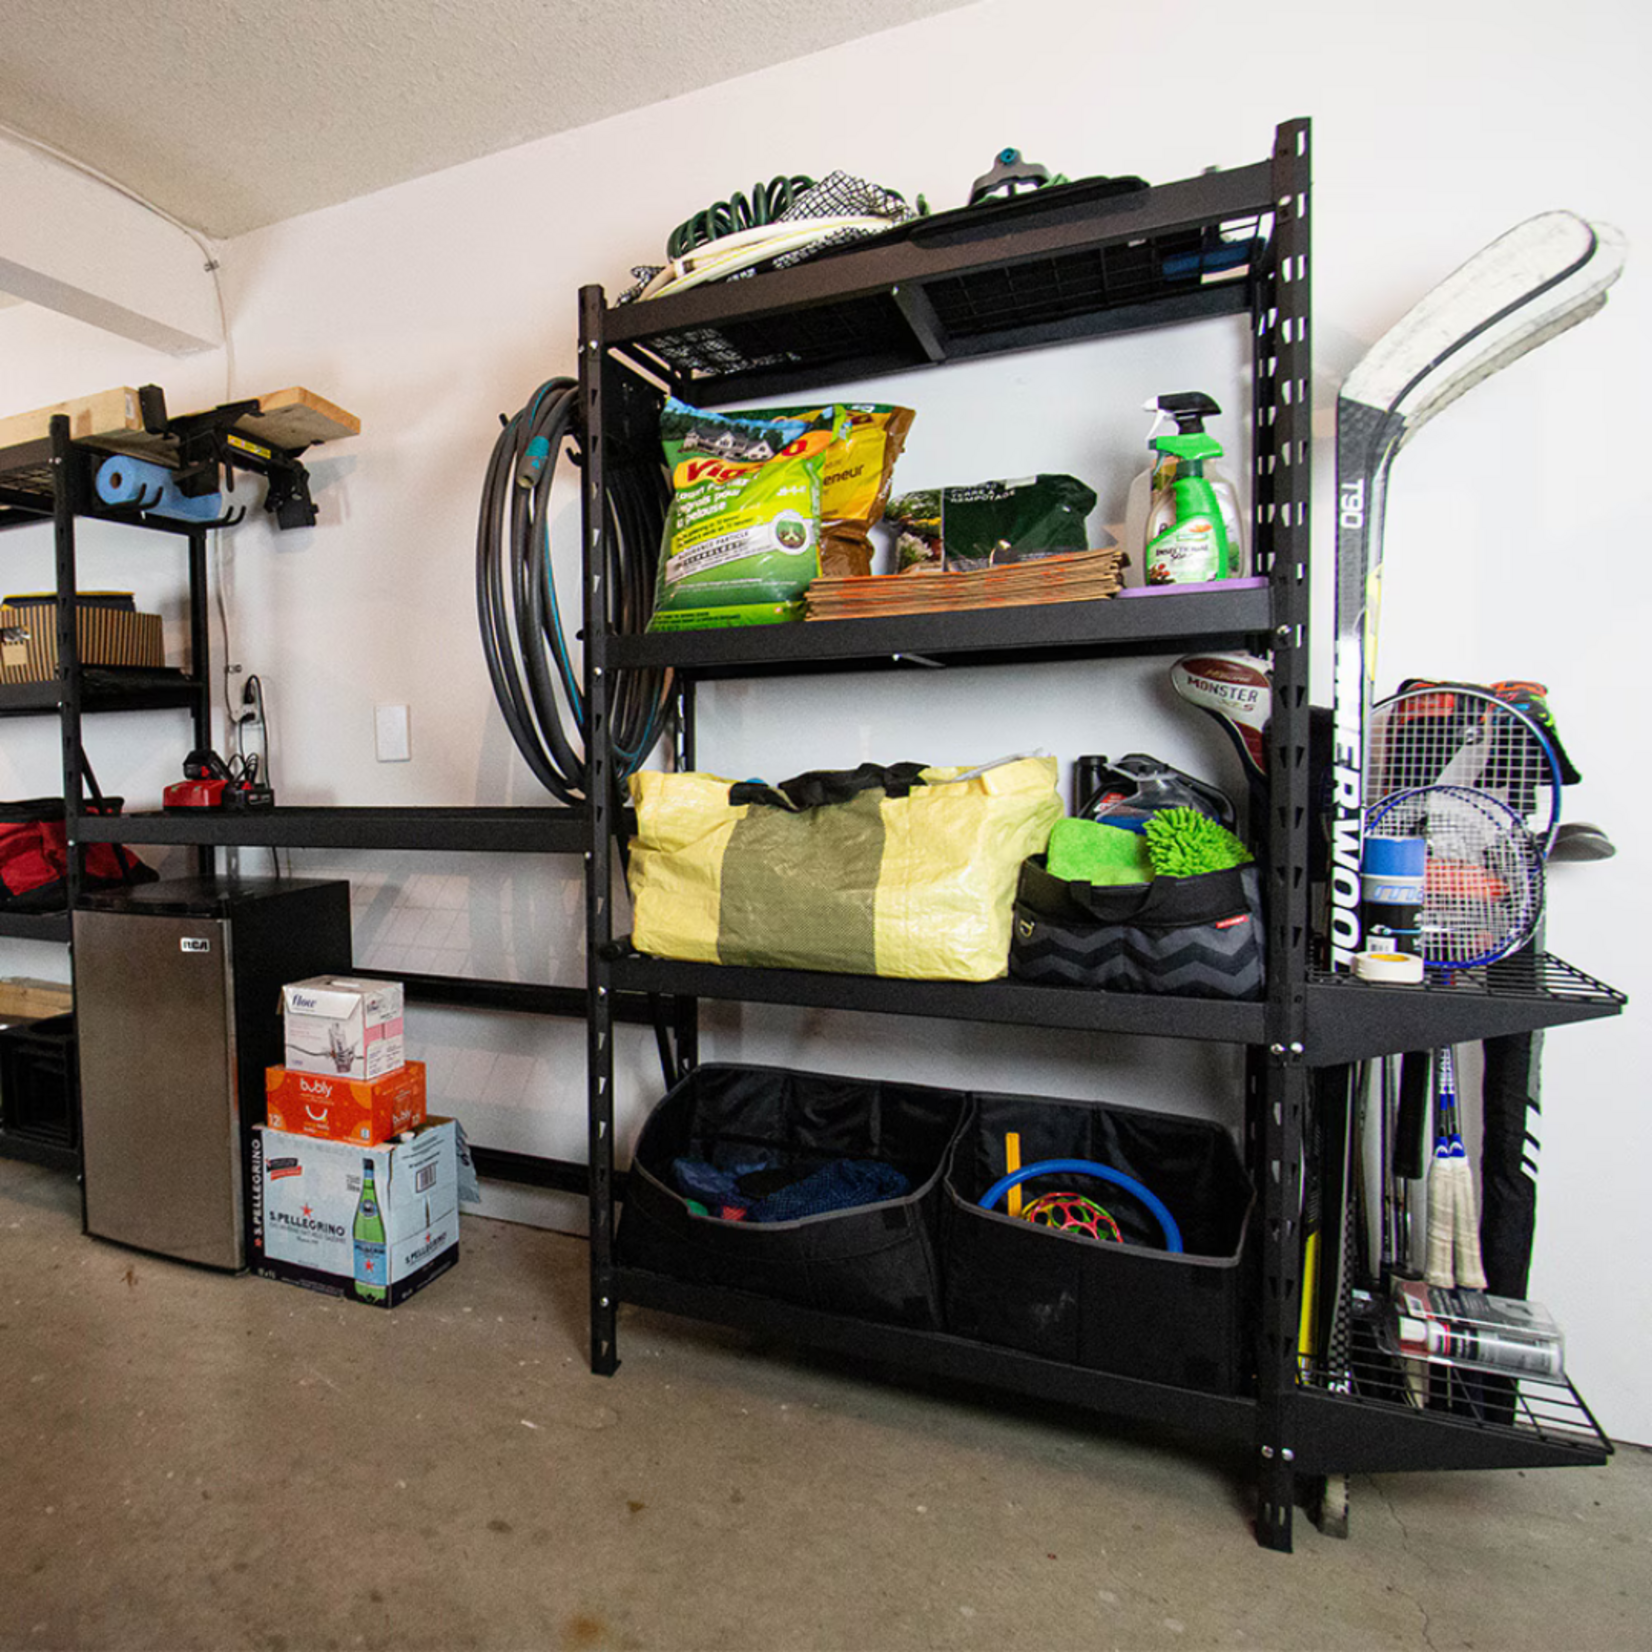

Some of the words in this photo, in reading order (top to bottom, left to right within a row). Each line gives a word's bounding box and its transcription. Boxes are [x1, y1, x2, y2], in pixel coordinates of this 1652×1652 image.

[1340, 478, 1364, 529] T90
[1187, 676, 1259, 703] MONSTER
[182, 940, 208, 951] RCA
[300, 1078, 333, 1098] bubly
[269, 1210, 345, 1237] S.PELLEGRINO
